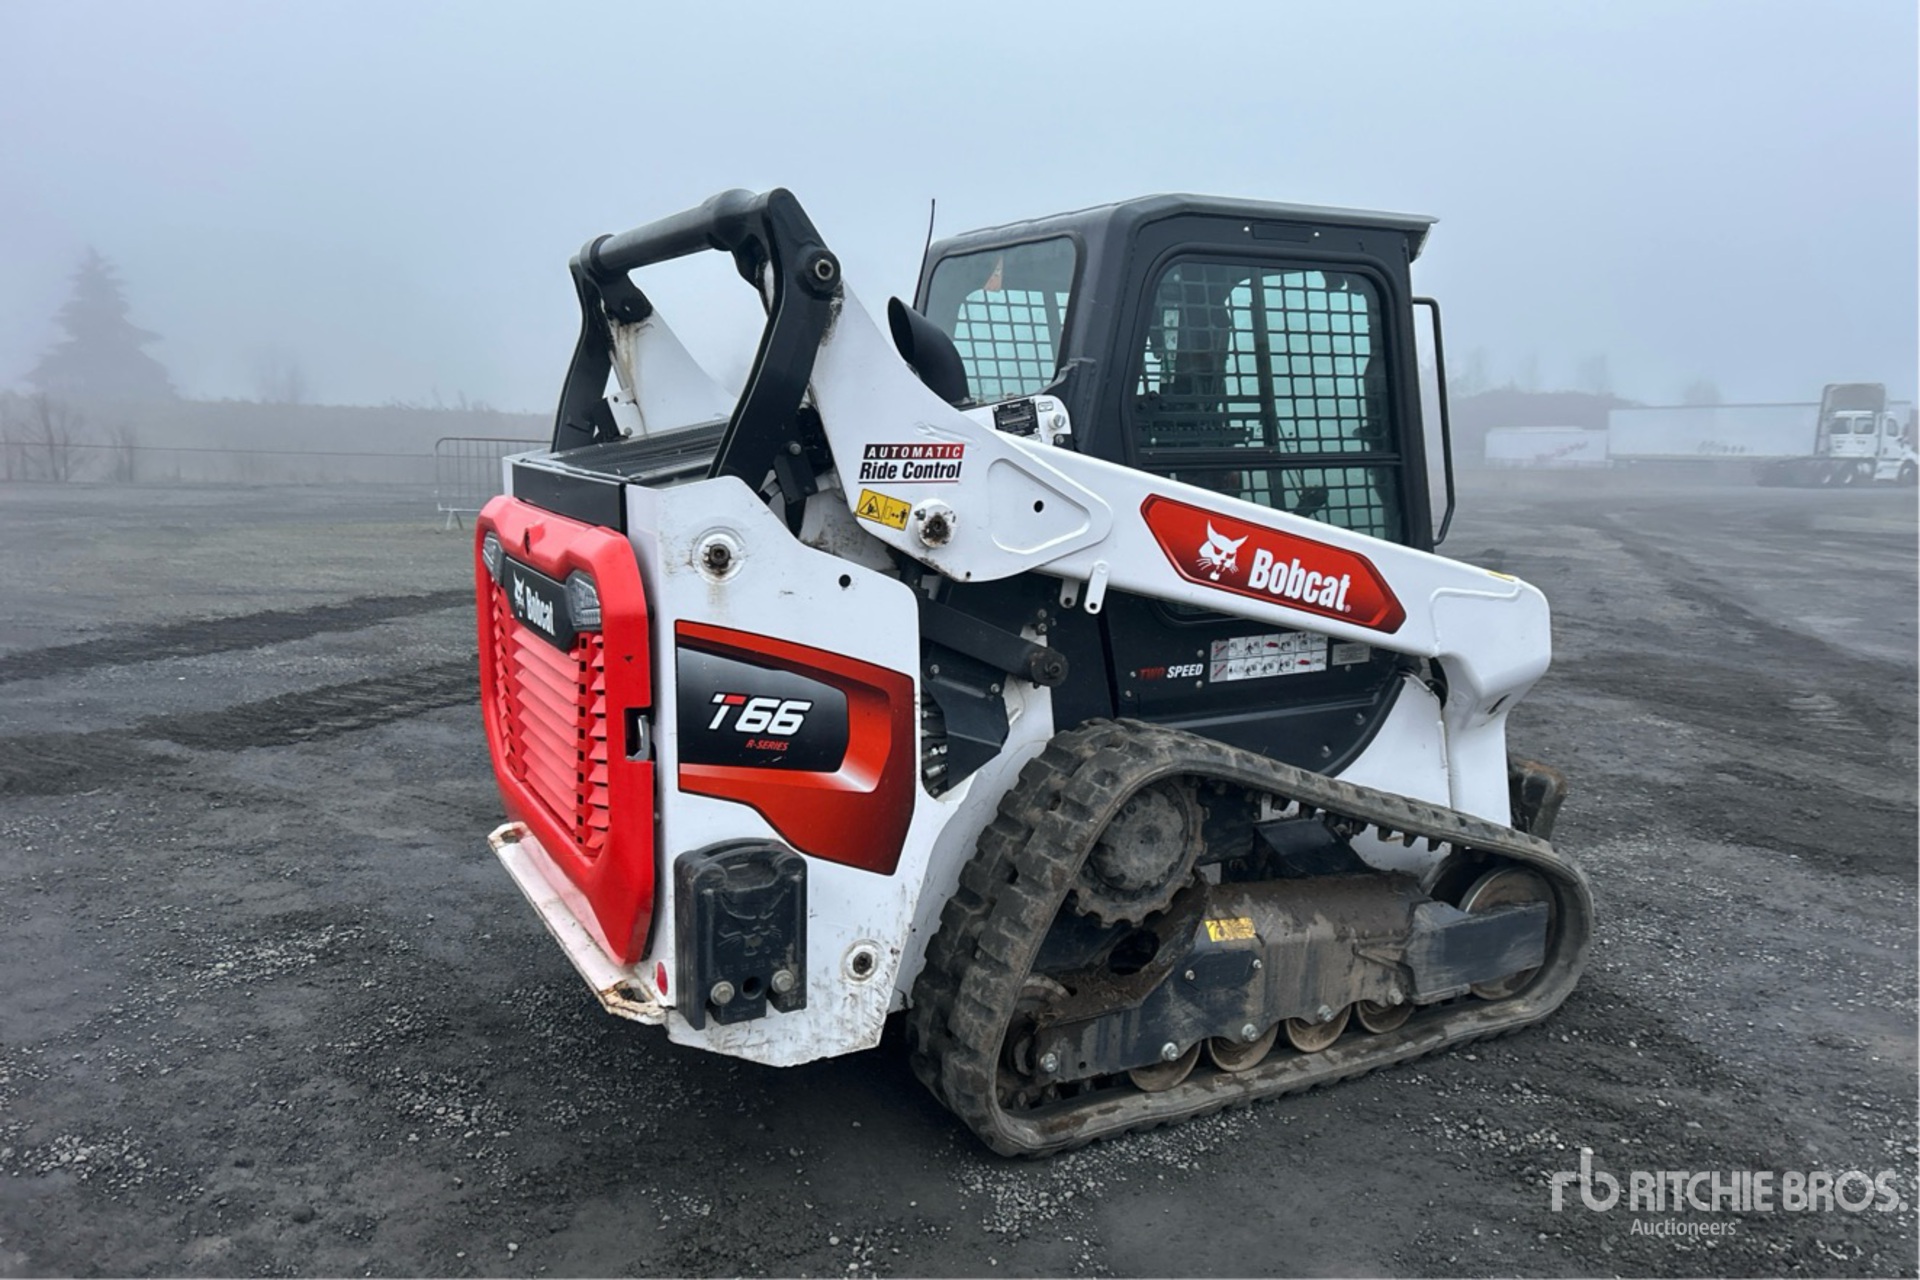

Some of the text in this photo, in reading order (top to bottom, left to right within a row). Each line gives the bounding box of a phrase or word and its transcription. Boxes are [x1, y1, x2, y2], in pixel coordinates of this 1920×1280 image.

[867, 446, 962, 458] AUTOMATIC
[859, 461, 962, 480] Ride Control
[1248, 548, 1351, 612] Bobcat
[526, 586, 555, 636] Bobcat
[1139, 663, 1203, 680] TWO SPEED
[708, 693, 812, 736] T66
[745, 739, 789, 751] R-SERIES
